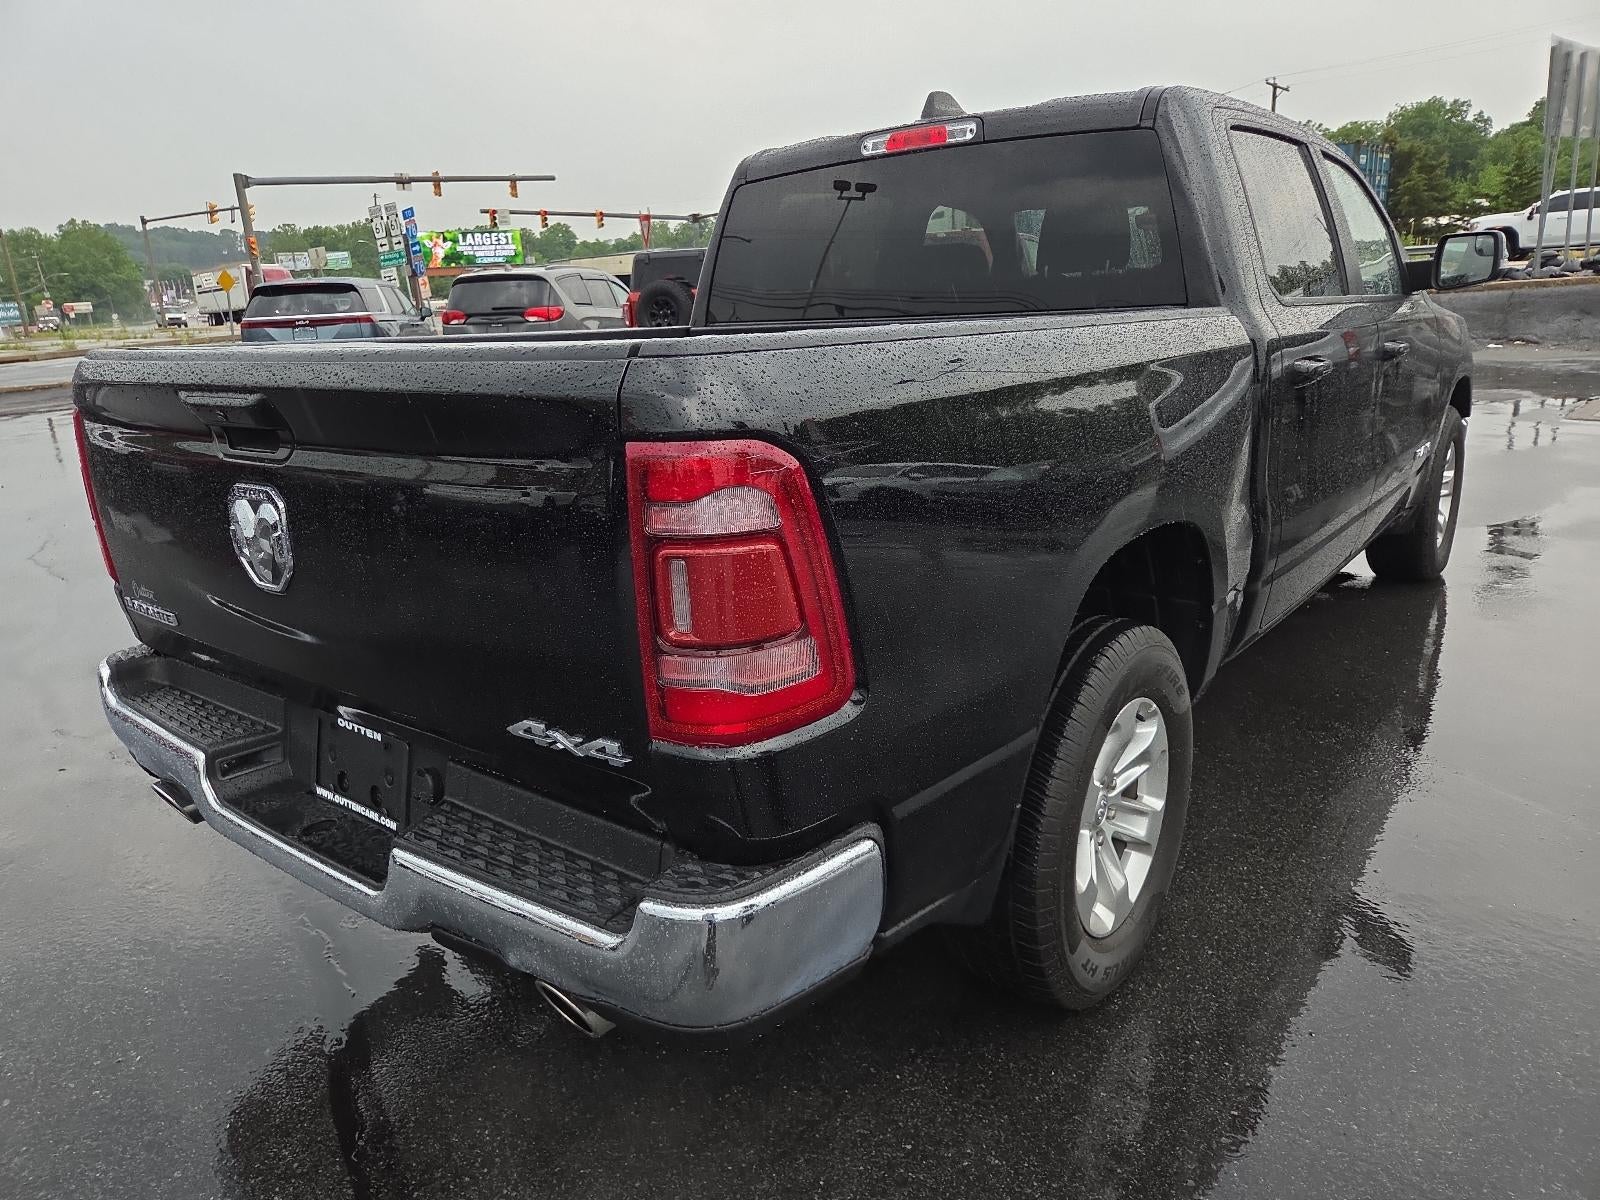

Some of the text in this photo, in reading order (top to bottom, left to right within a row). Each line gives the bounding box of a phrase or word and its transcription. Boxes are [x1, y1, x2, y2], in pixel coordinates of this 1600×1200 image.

[375, 221, 384, 234] 61
[390, 219, 399, 231] 61
[407, 224, 417, 237] 78
[458, 232, 513, 246] LARGEST
[414, 261, 425, 275] 78
[337, 717, 382, 742] OUTTEN
[316, 785, 397, 831] WWW.OUTTENCARS.COM
